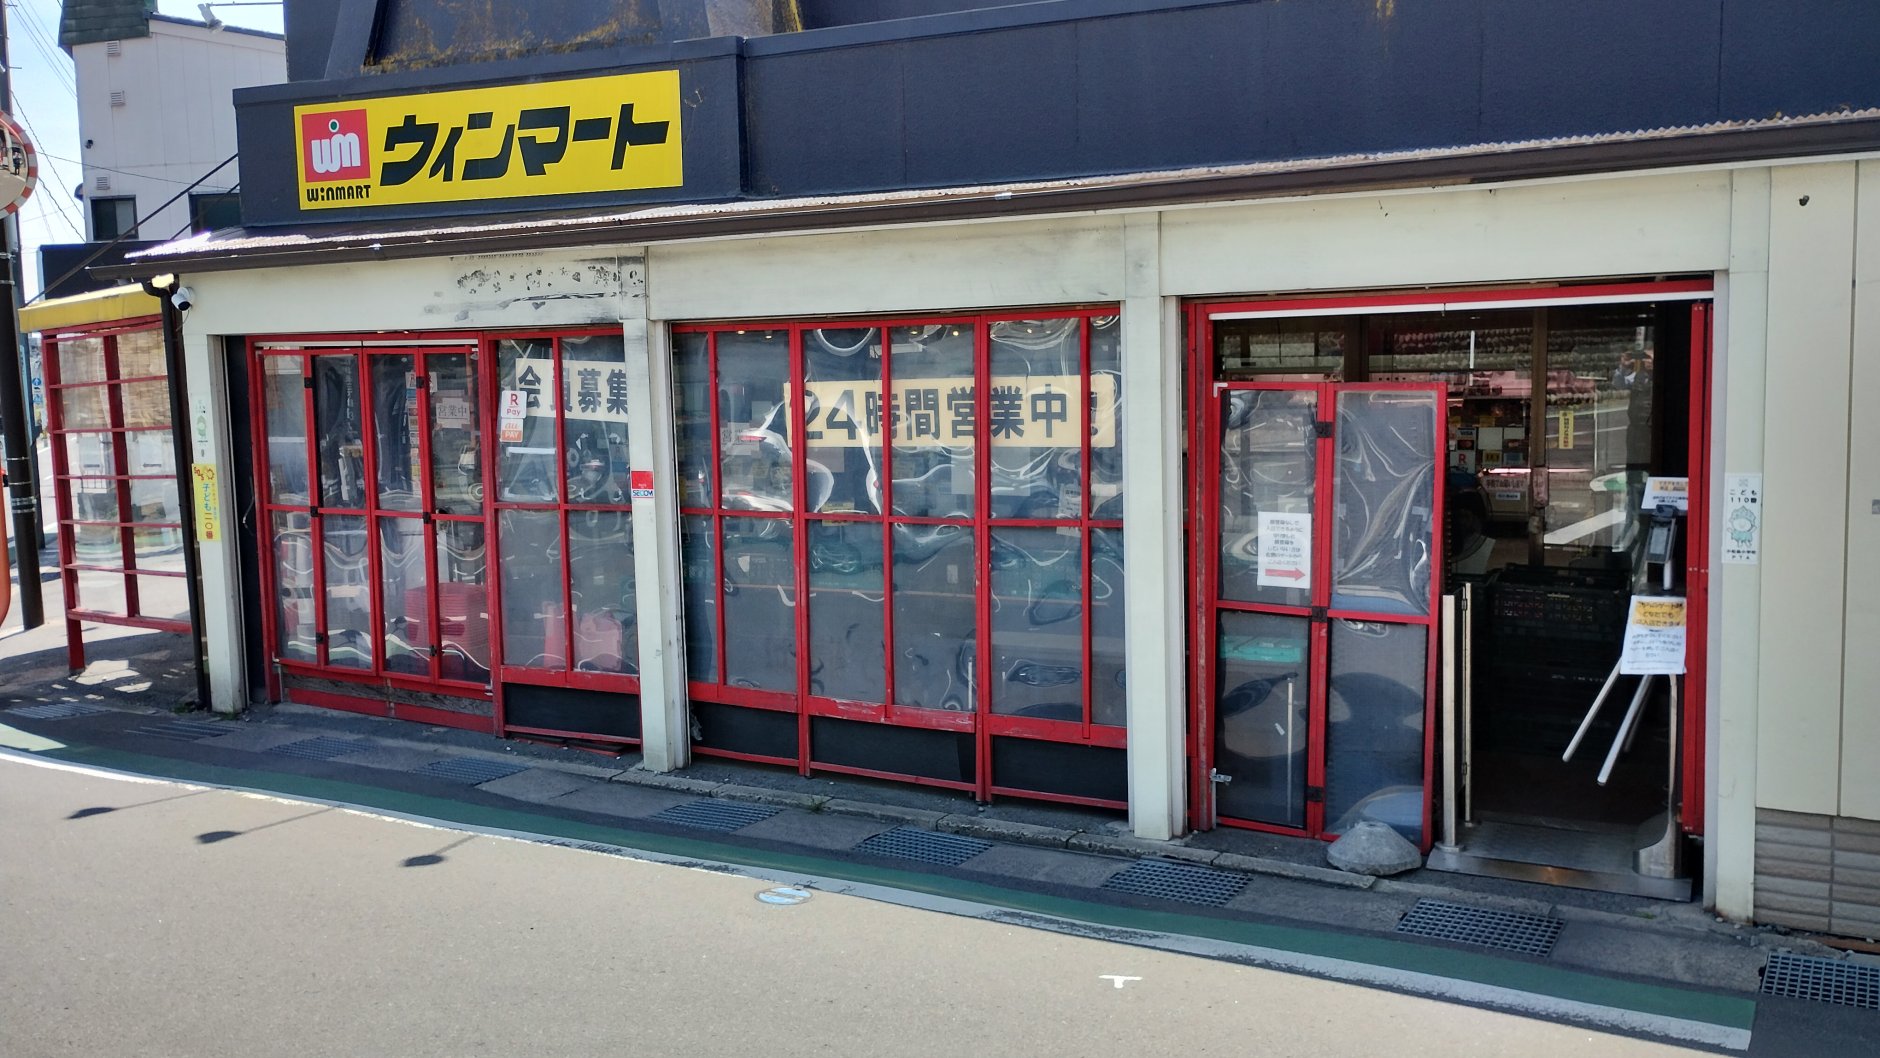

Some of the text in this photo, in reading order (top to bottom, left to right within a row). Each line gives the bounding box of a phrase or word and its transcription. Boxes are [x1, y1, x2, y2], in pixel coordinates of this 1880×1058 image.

[379, 103, 671, 187] ウィンマート
[510, 393, 518, 406] R
[506, 408, 521, 417] Pay
[505, 431, 519, 439] PAY
[632, 489, 654, 497] SECOM
